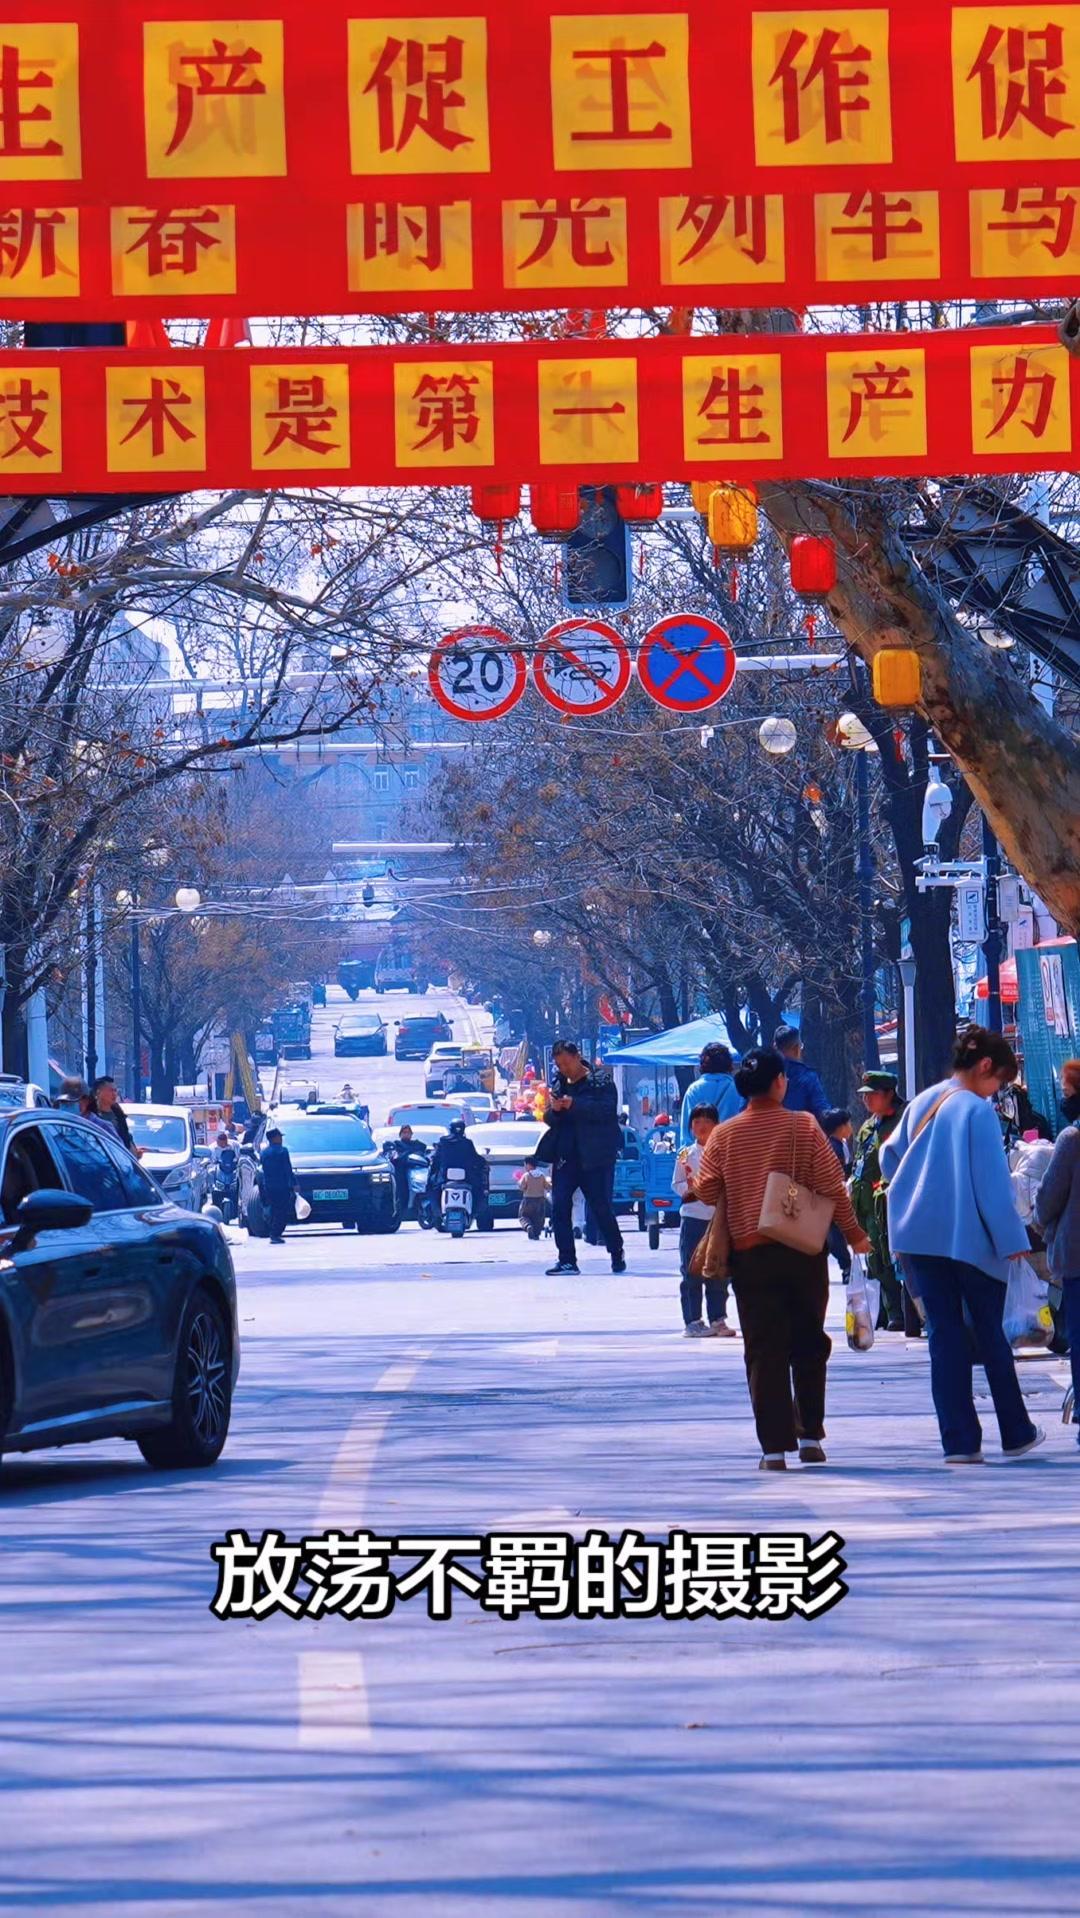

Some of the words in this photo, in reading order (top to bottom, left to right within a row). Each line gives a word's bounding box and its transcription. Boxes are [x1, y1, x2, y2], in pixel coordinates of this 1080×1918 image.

[0, 358, 1056, 460] 技术是第一生产力
[451, 653, 504, 694] 20
